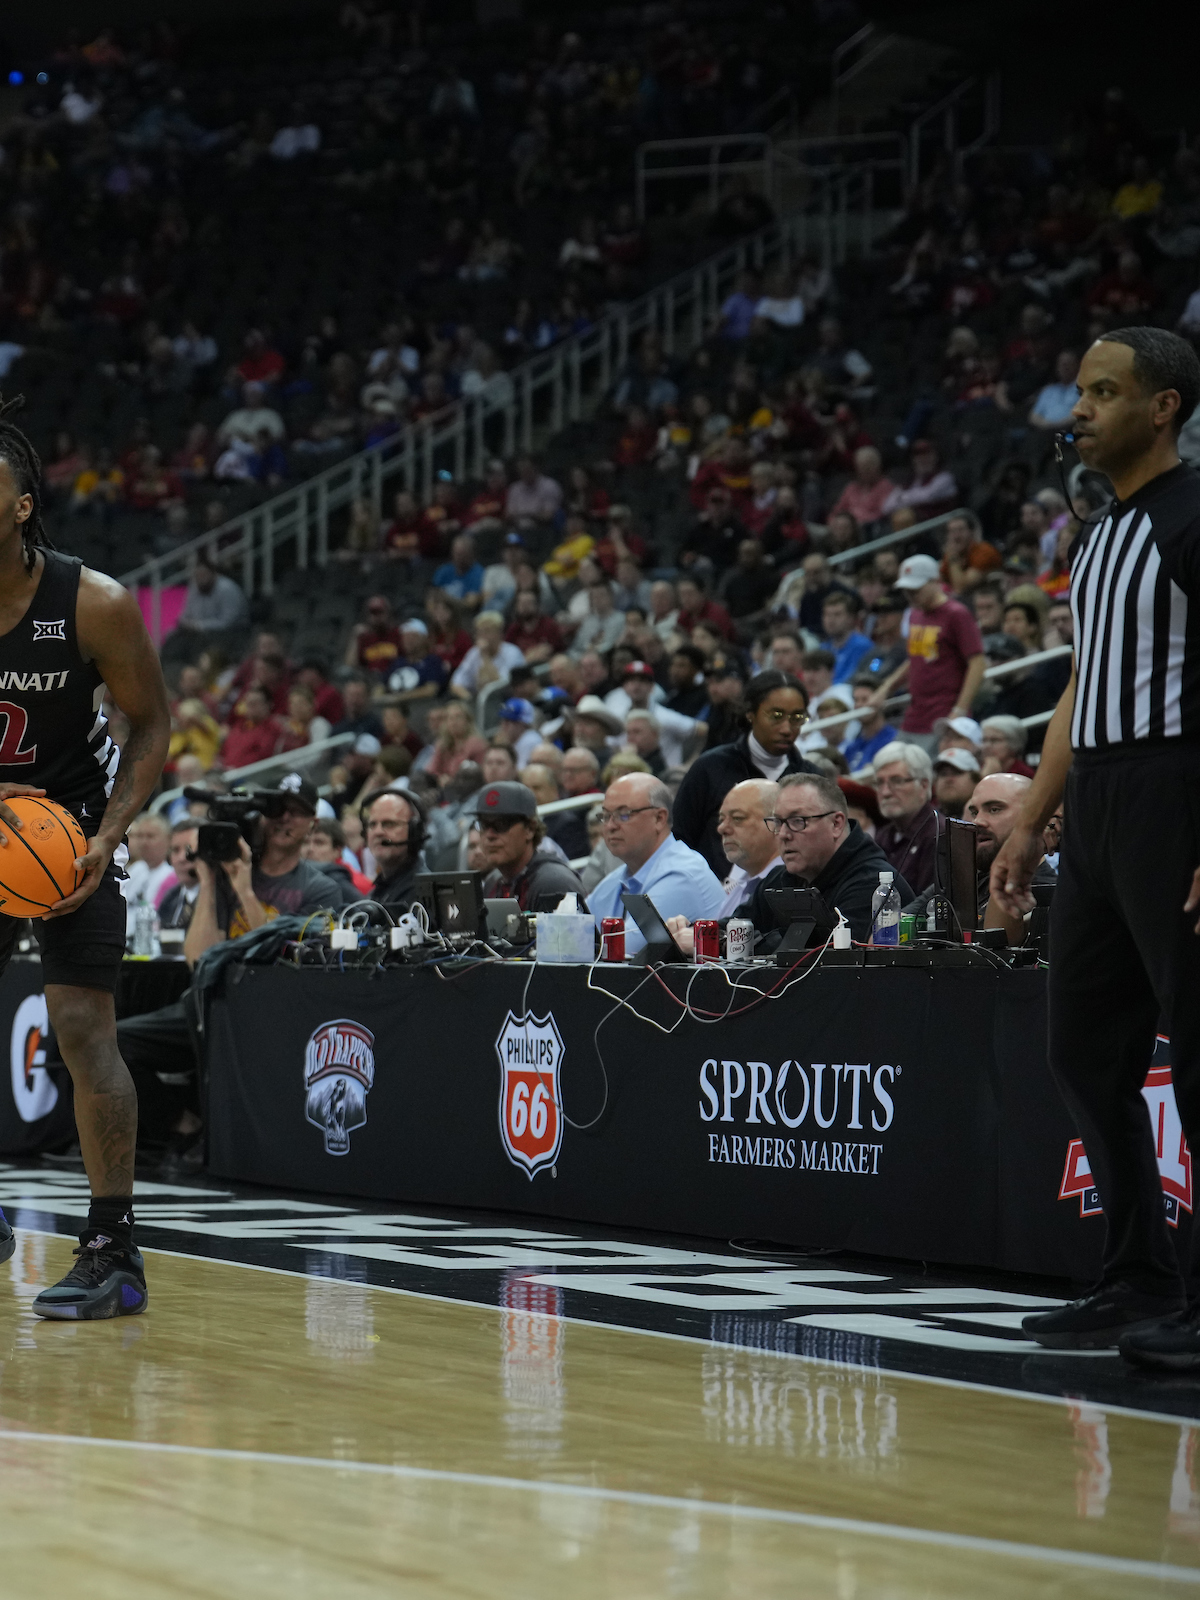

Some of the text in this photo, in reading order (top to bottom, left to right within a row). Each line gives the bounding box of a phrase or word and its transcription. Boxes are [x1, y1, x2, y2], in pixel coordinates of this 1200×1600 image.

[729, 929, 752, 943] Pepper
[305, 1027, 374, 1087] OLD TRAPPER
[507, 1038, 554, 1066] PHILLIPS
[510, 1081, 550, 1139] 66
[708, 1133, 883, 1175] FARMERS MARKET
